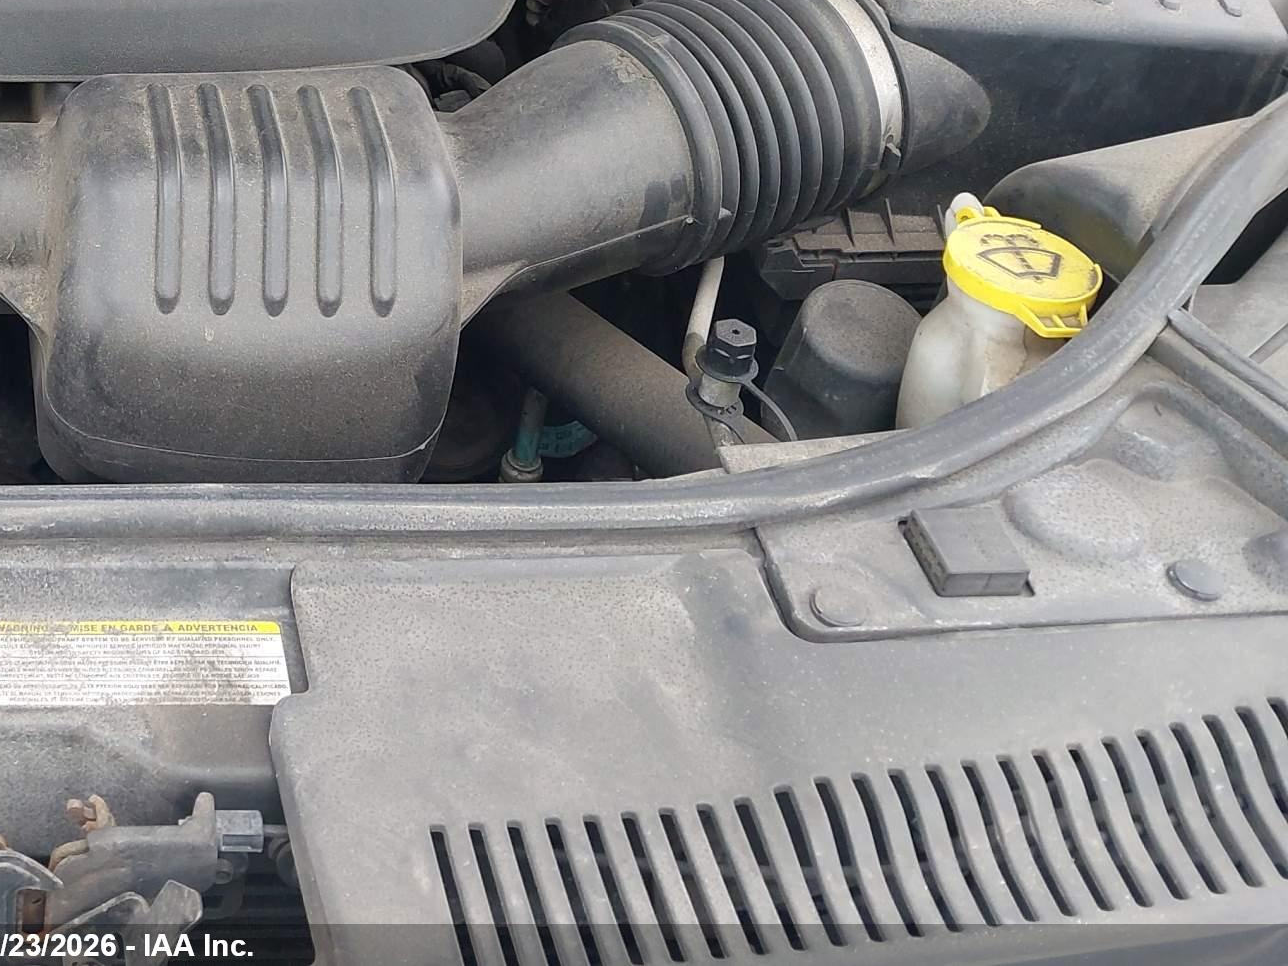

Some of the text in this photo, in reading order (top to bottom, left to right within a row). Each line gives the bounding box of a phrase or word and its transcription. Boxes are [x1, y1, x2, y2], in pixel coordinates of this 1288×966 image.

[70, 624, 98, 632] MISE
[101, 624, 116, 632] EN
[120, 624, 158, 632] GARDE
[177, 624, 258, 632] ADVERTENCIA
